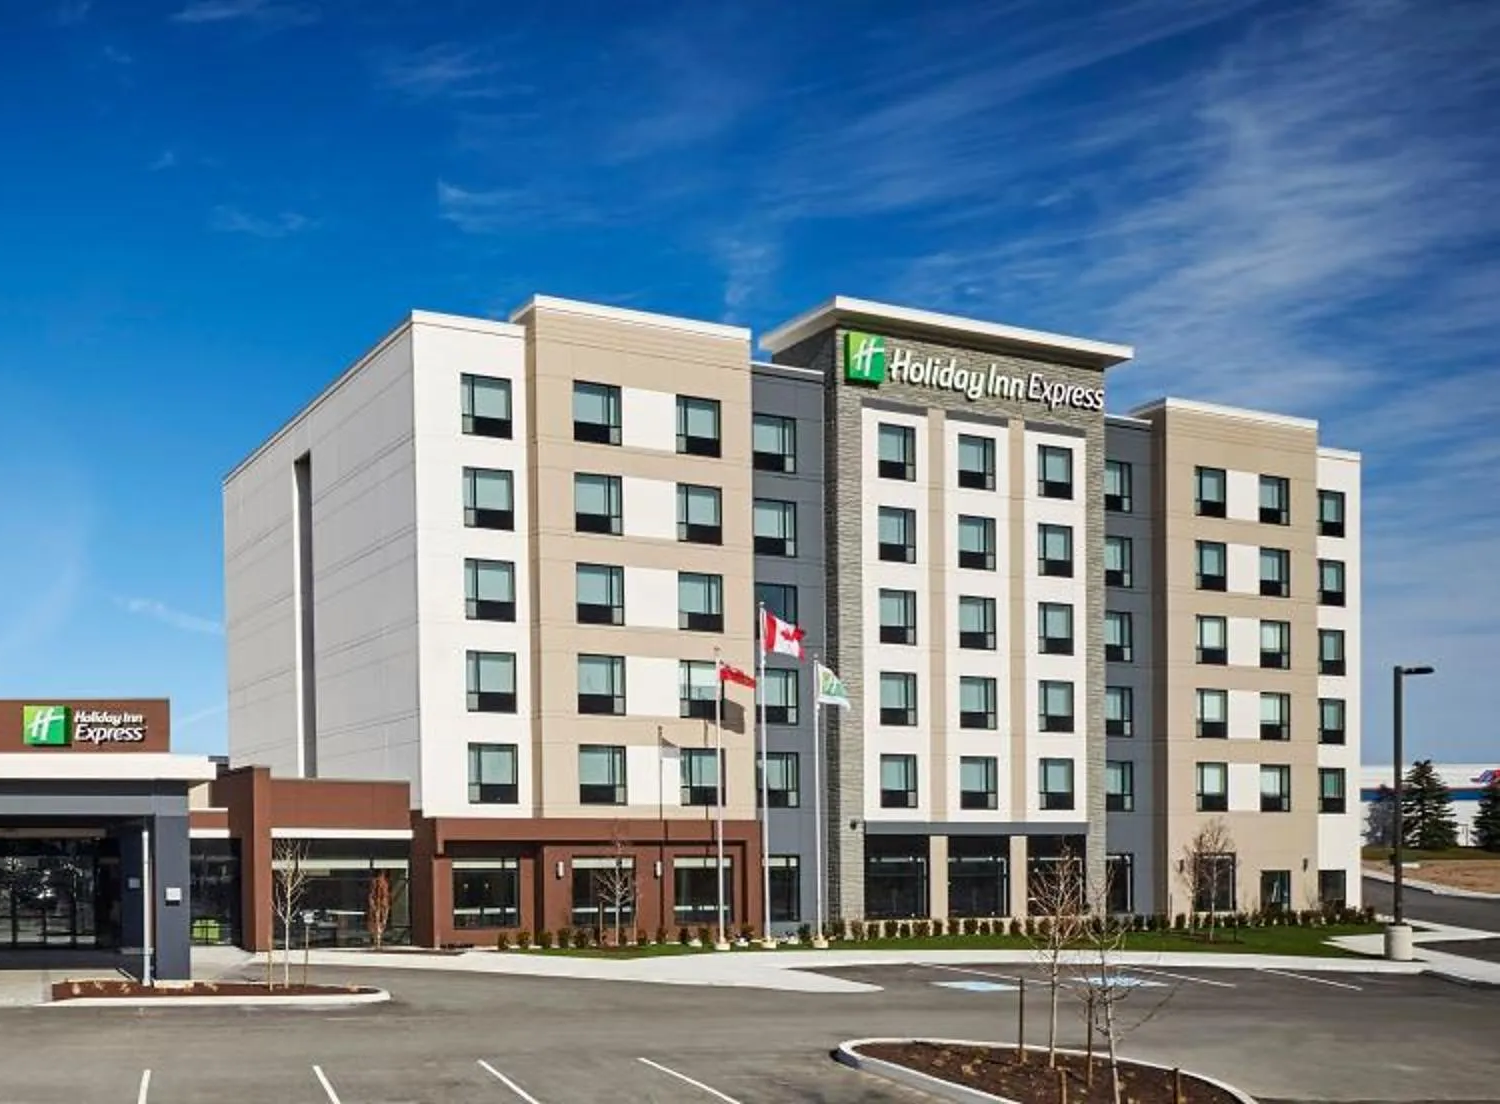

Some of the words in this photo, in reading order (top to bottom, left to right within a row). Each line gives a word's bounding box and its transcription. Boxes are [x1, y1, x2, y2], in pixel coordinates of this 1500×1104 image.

[890, 349, 985, 399] Holiday
[987, 363, 1024, 400] Inn
[1028, 373, 1105, 410] Express
[74, 710, 122, 726] Holiday
[123, 711, 143, 723] Inn
[75, 723, 144, 744] Express
